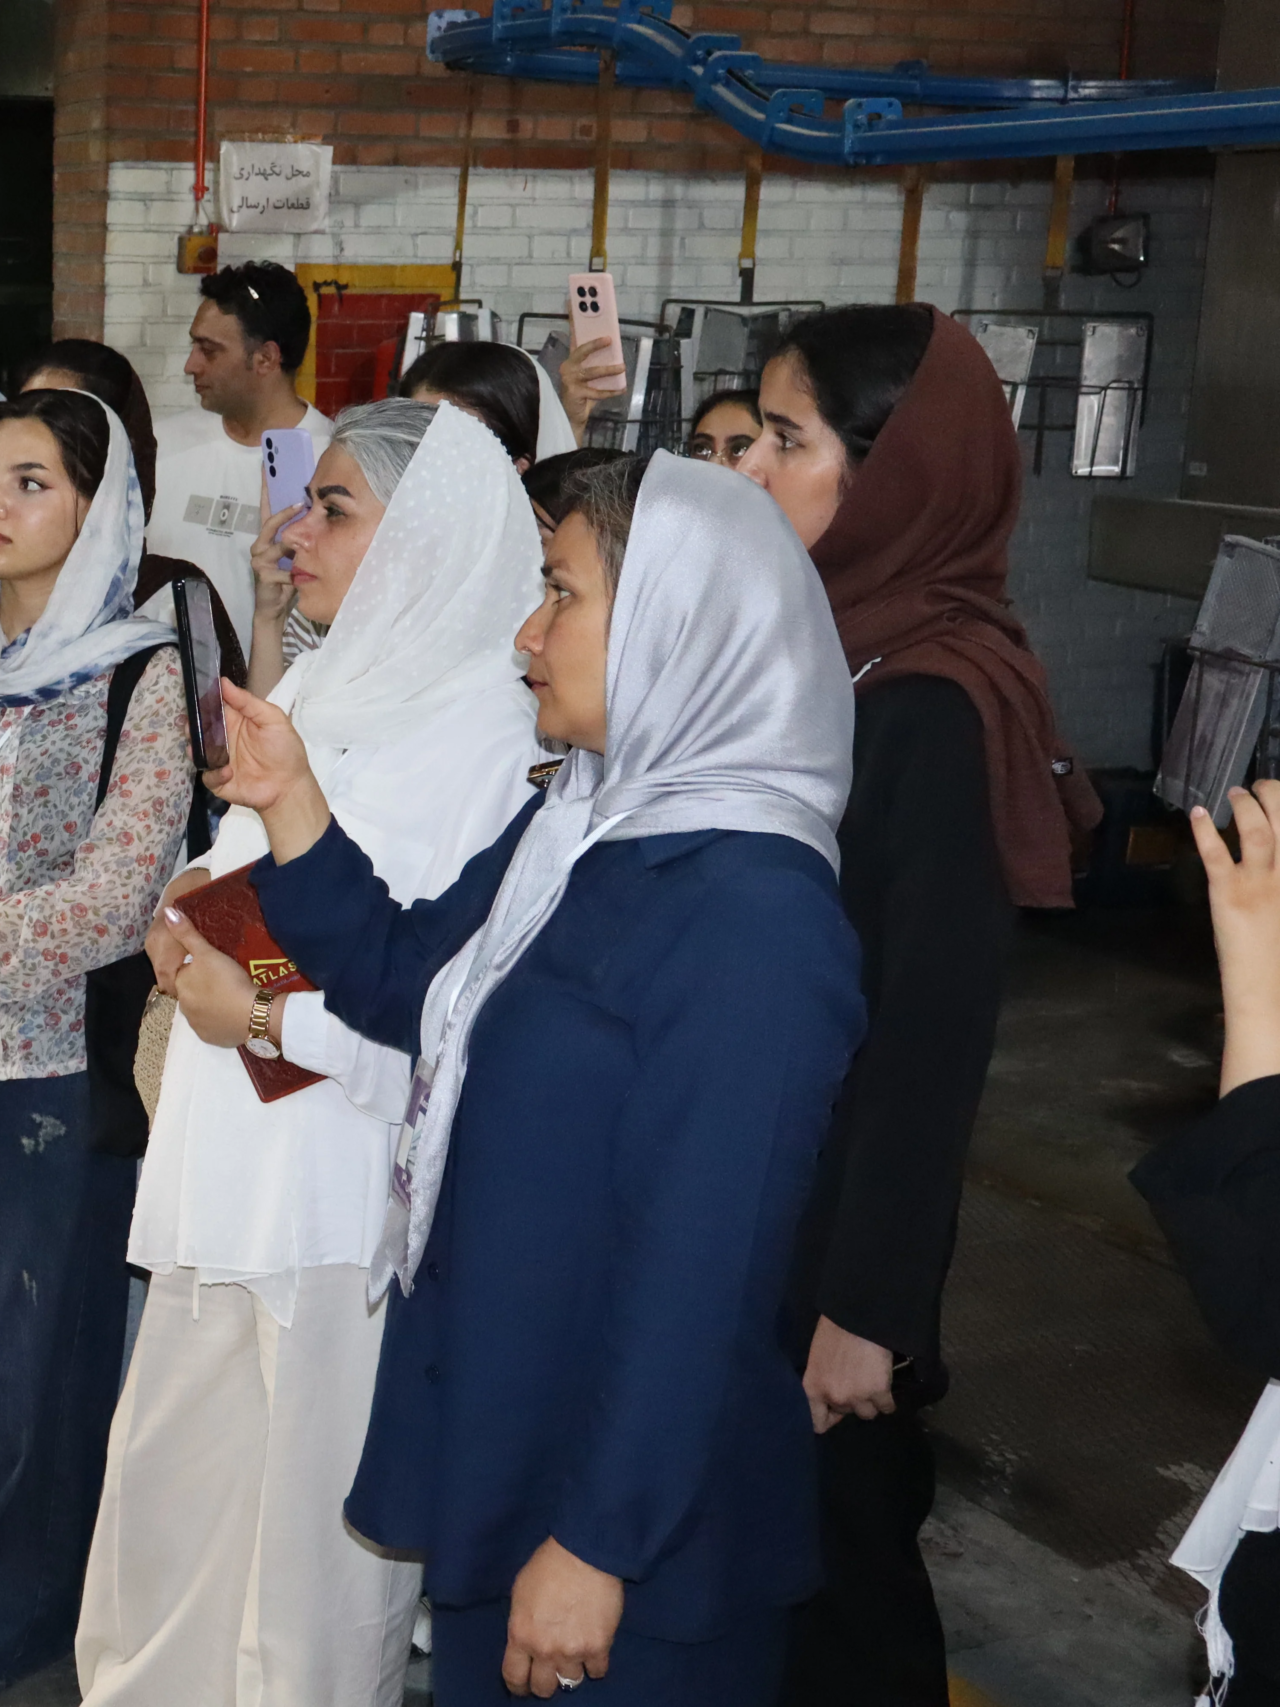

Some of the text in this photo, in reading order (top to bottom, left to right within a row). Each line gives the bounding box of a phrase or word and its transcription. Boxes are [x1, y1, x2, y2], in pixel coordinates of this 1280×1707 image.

[233, 162, 311, 181] محل نگهداری
[230, 196, 311, 215] قطعات ارسالی
[252, 961, 297, 986] ATLAS
